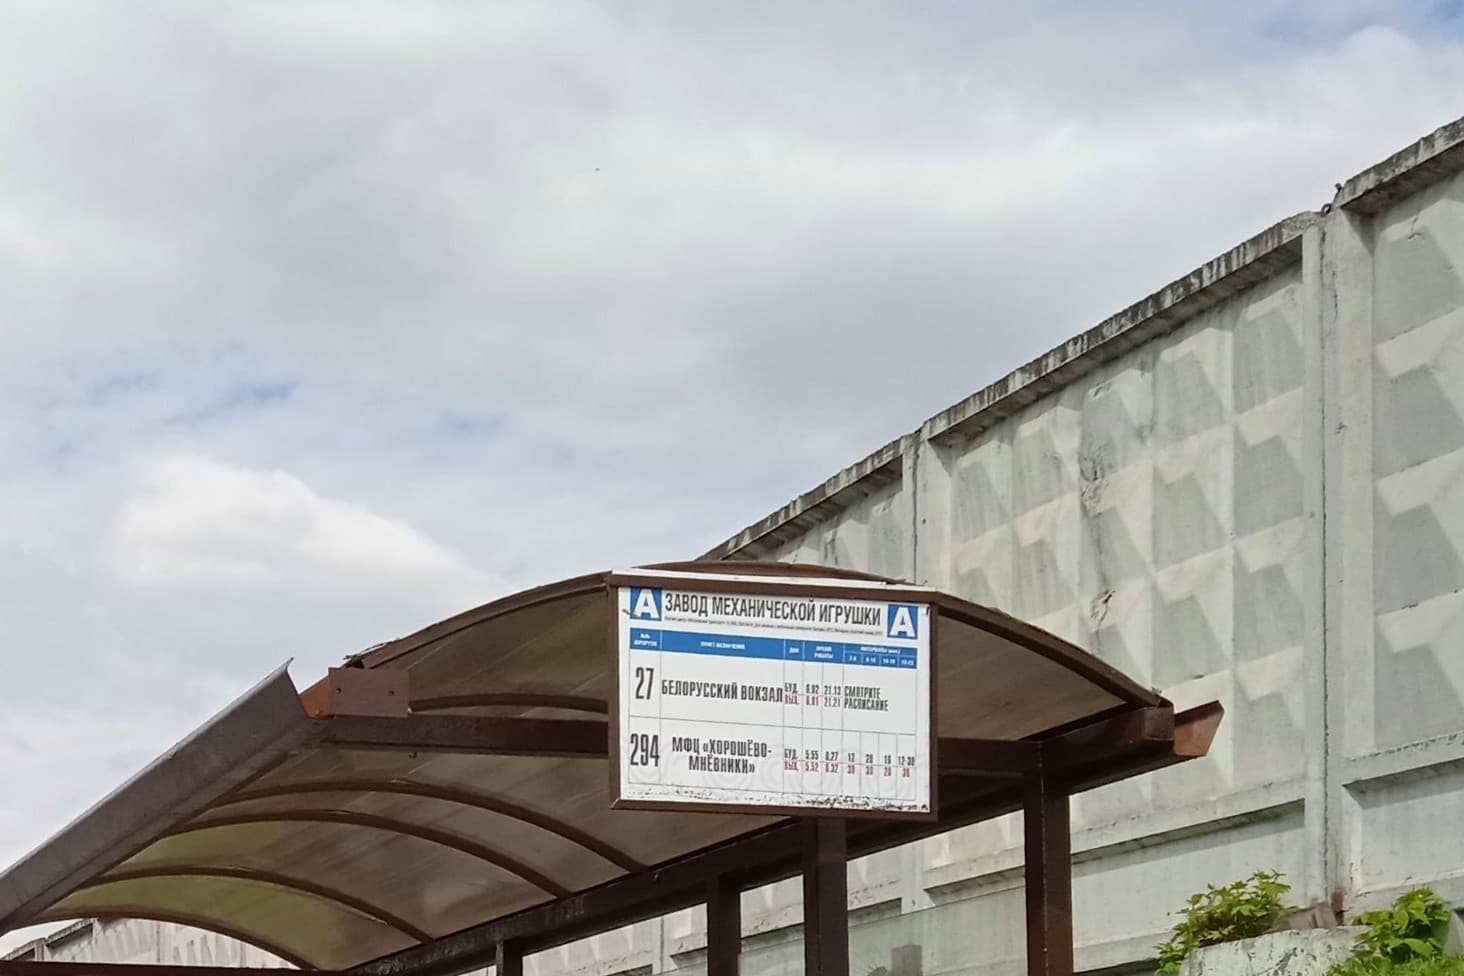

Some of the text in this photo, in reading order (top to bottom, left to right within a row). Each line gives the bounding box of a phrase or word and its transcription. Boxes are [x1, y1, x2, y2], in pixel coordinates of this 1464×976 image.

[665, 593, 708, 617] ЗАВОД
[711, 595, 815, 621] МЕХАНИЧЕСКОЙ
[819, 603, 881, 626] ИГРУШКИ
[635, 667, 654, 700] 27
[661, 679, 783, 703] БЕЛОРУССКИЙ ВОКЗАЛ
[844, 685, 881, 700] СМОТРИТЕ
[844, 699, 889, 712] РАСПИСАНИЕ
[630, 733, 660, 767] 294
[672, 736, 700, 755] МФЦ
[689, 754, 755, 774] МНЁВНИКИ»
